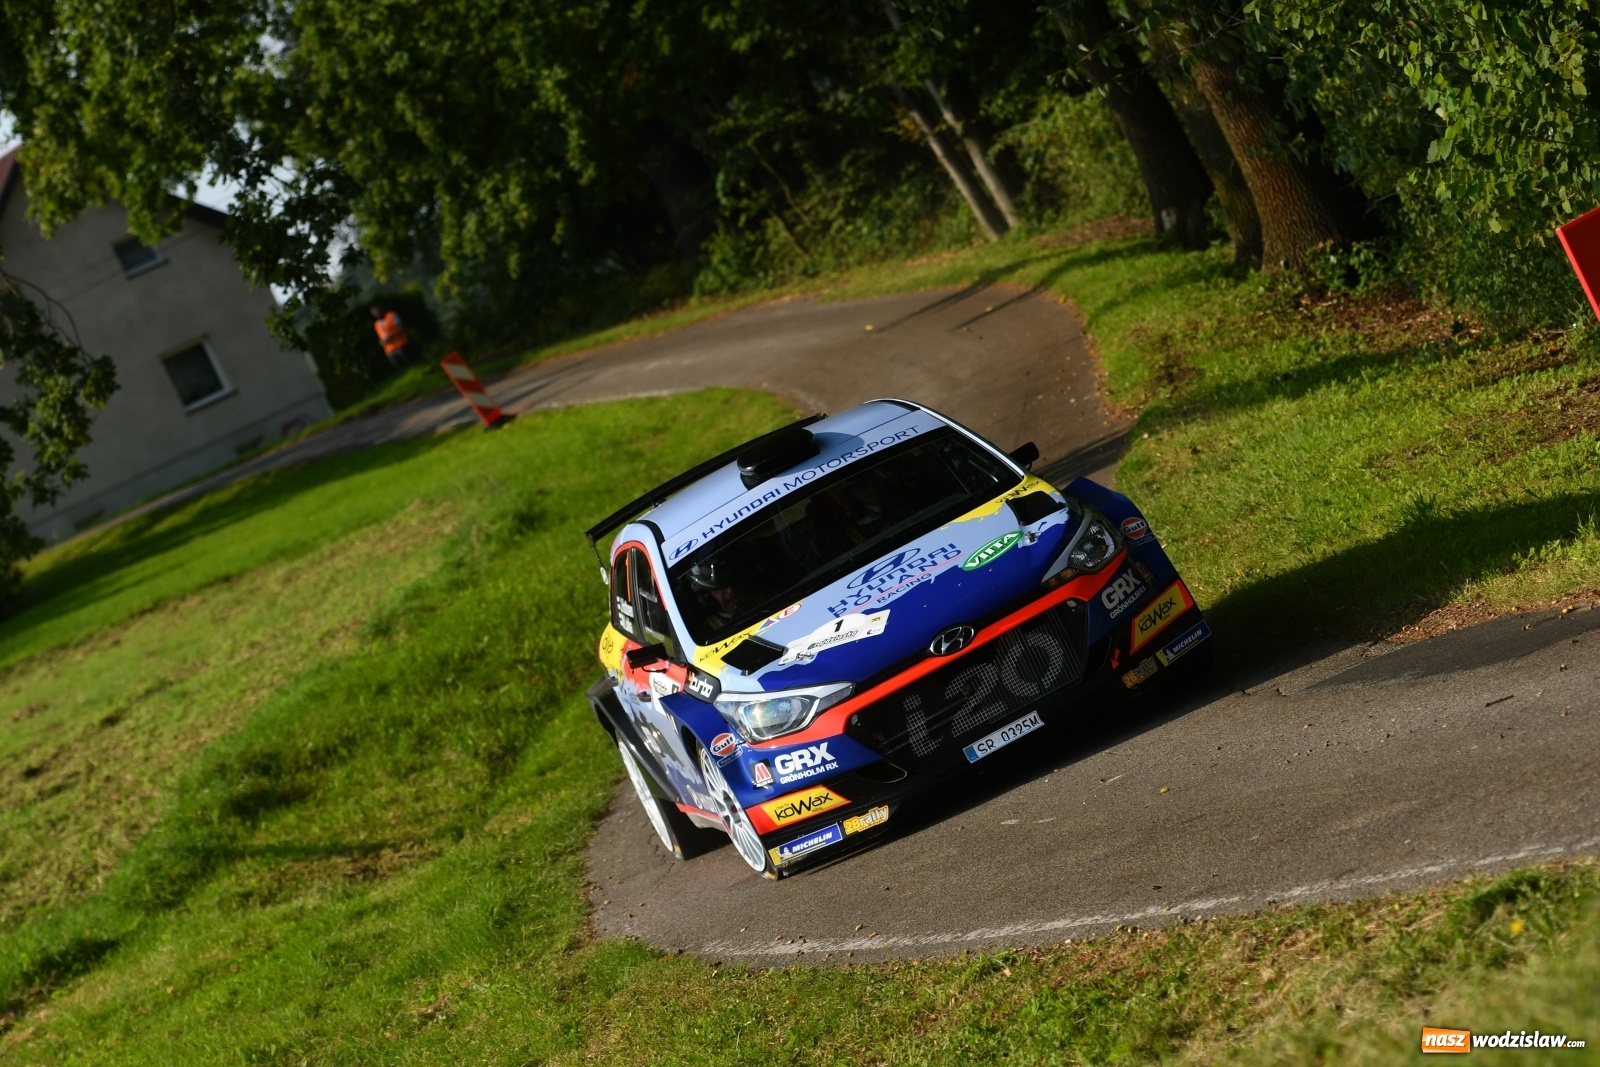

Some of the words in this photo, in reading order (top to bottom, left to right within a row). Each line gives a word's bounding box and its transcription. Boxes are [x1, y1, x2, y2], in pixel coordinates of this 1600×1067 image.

[701, 488, 782, 539] HYUNDAI
[782, 425, 919, 491] MOTORSPORT
[1123, 520, 1145, 533] Gulf
[827, 543, 957, 613] HYUNDAI
[833, 549, 962, 618] POLAND
[876, 573, 932, 604] RACING
[1101, 568, 1141, 610] GRX
[833, 618, 845, 633] 1
[1172, 628, 1203, 654] MICHELIN
[903, 631, 1065, 758] i20
[712, 735, 735, 752] Gulf
[977, 738, 997, 755] SR
[1000, 714, 1041, 743] 0325M
[774, 742, 836, 775] GRX
[780, 766, 826, 785] GRÖNHOLM
[826, 761, 839, 770] RX
[792, 831, 833, 853] MICHELIN
